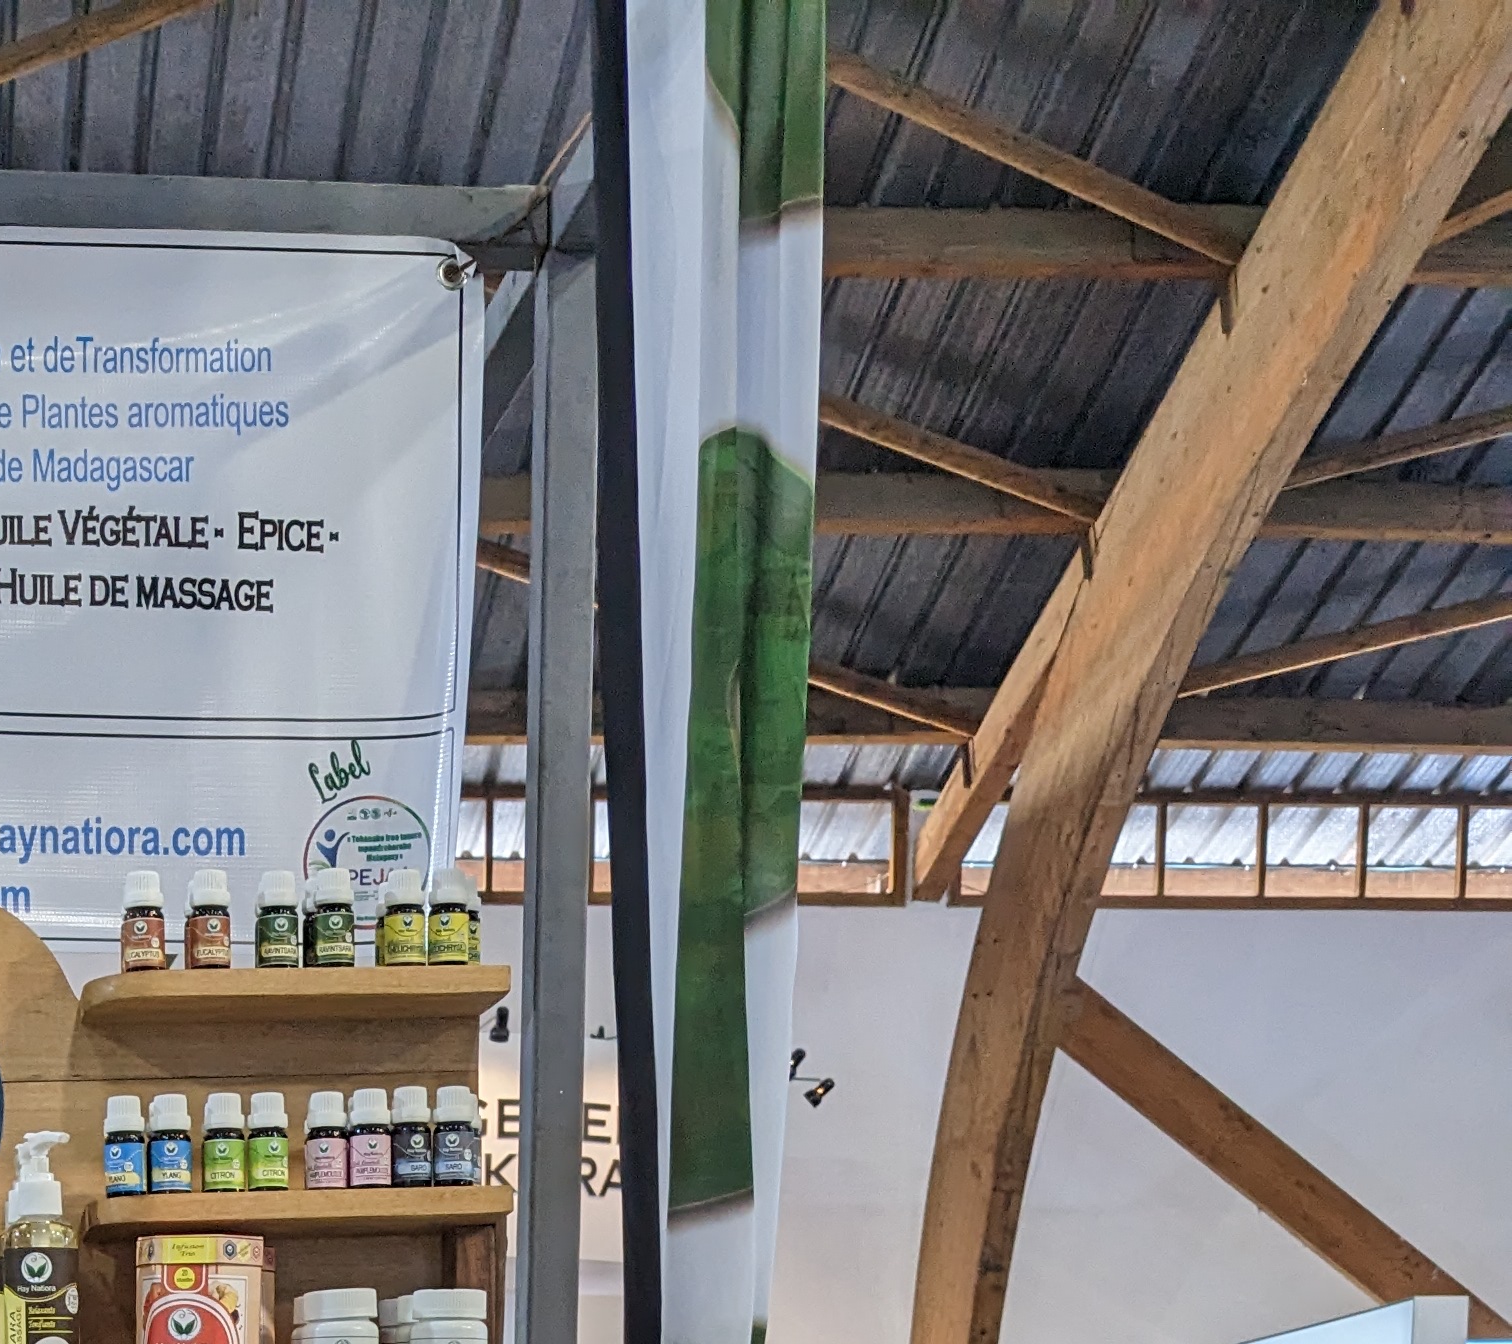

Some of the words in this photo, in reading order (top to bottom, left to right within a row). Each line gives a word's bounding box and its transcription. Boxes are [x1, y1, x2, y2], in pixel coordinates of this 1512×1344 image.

[11, 336, 35, 373] et
[23, 394, 119, 431] Plantes
[127, 397, 289, 436] aromatiques
[33, 448, 194, 491] Madagascar
[308, 739, 371, 804] Label
